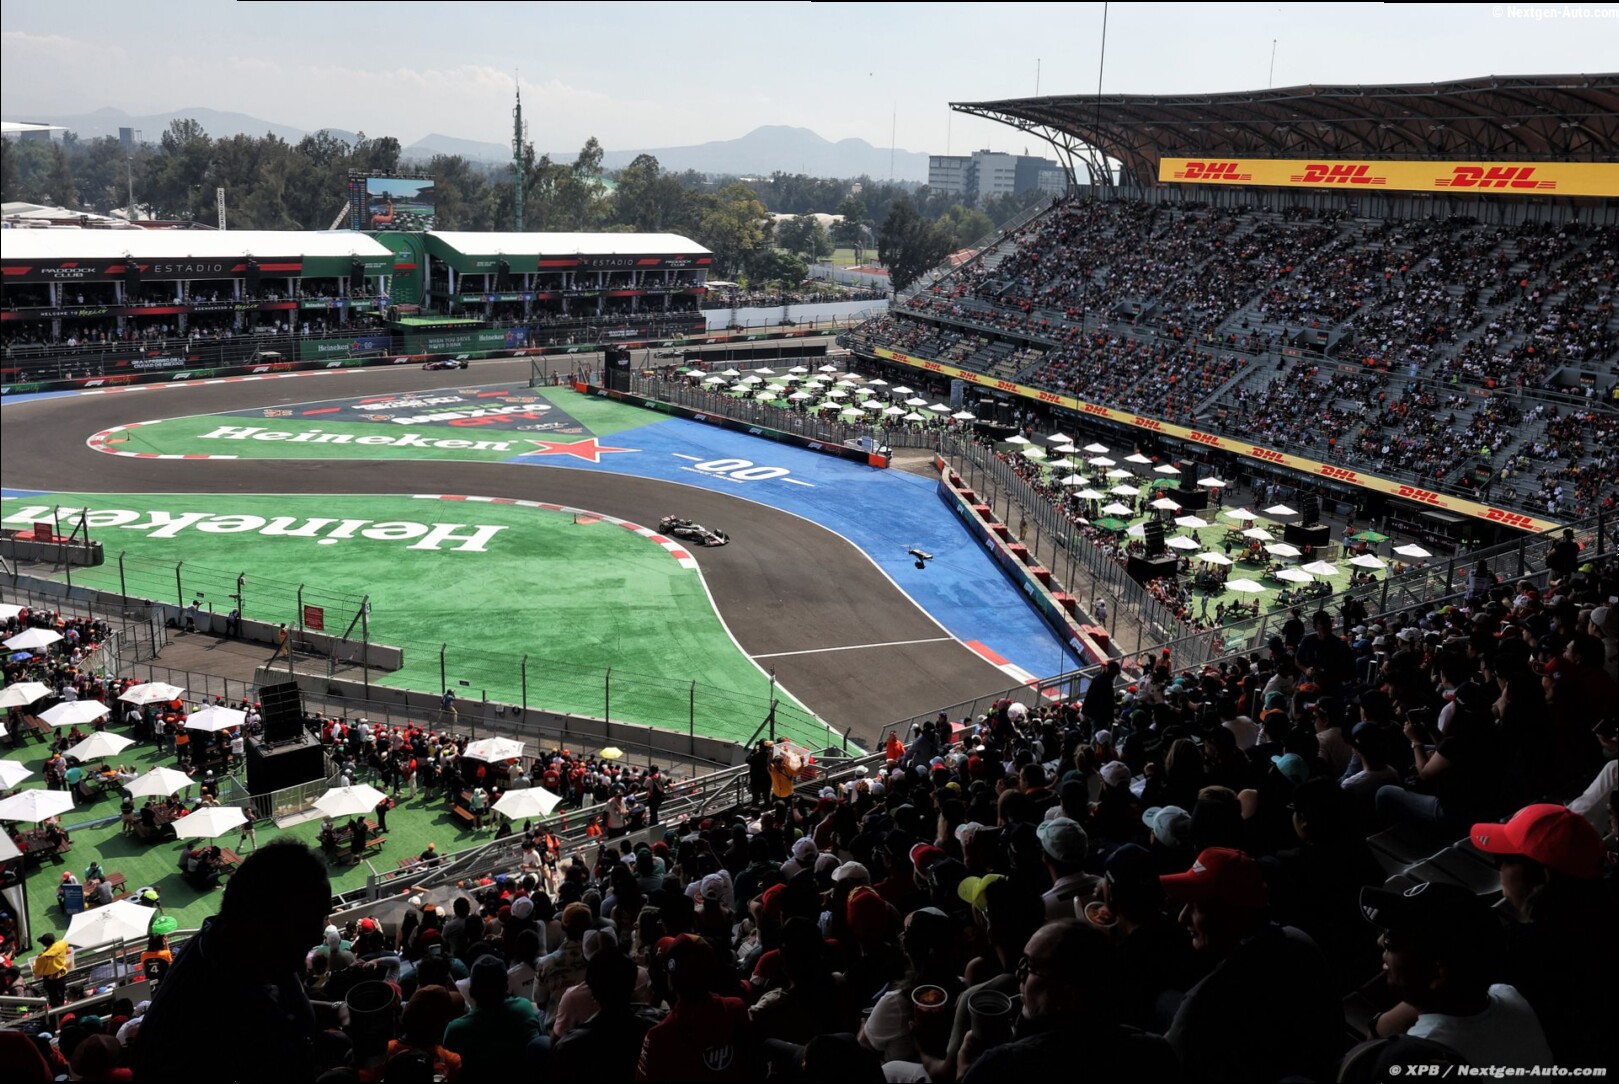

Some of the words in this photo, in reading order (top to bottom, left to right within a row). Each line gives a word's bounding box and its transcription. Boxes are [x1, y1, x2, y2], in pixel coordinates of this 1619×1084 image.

[1184, 162, 1242, 180] DHL
[1302, 164, 1372, 184] DHL
[1450, 166, 1539, 188] DHL
[154, 264, 222, 272] ESTADIO
[318, 344, 350, 352] Heineken
[892, 352, 908, 362] DHL
[924, 361, 941, 371] DHL
[960, 370, 978, 382] DHL
[998, 380, 1018, 392] DHL
[1039, 392, 1061, 404] DHL
[391, 404, 552, 425] MEXICO
[1084, 403, 1109, 416] DHL
[448, 411, 541, 426] CITY
[1135, 417, 1161, 430] DHL
[197, 426, 511, 450] Heineken
[1190, 431, 1219, 446] DHL
[1252, 447, 1284, 463] DHL
[694, 458, 790, 480] 0.0
[1320, 465, 1358, 482] DHL
[1398, 485, 1441, 505] DHL
[1485, 508, 1536, 531] DHL
[2, 505, 509, 552] Heineken
